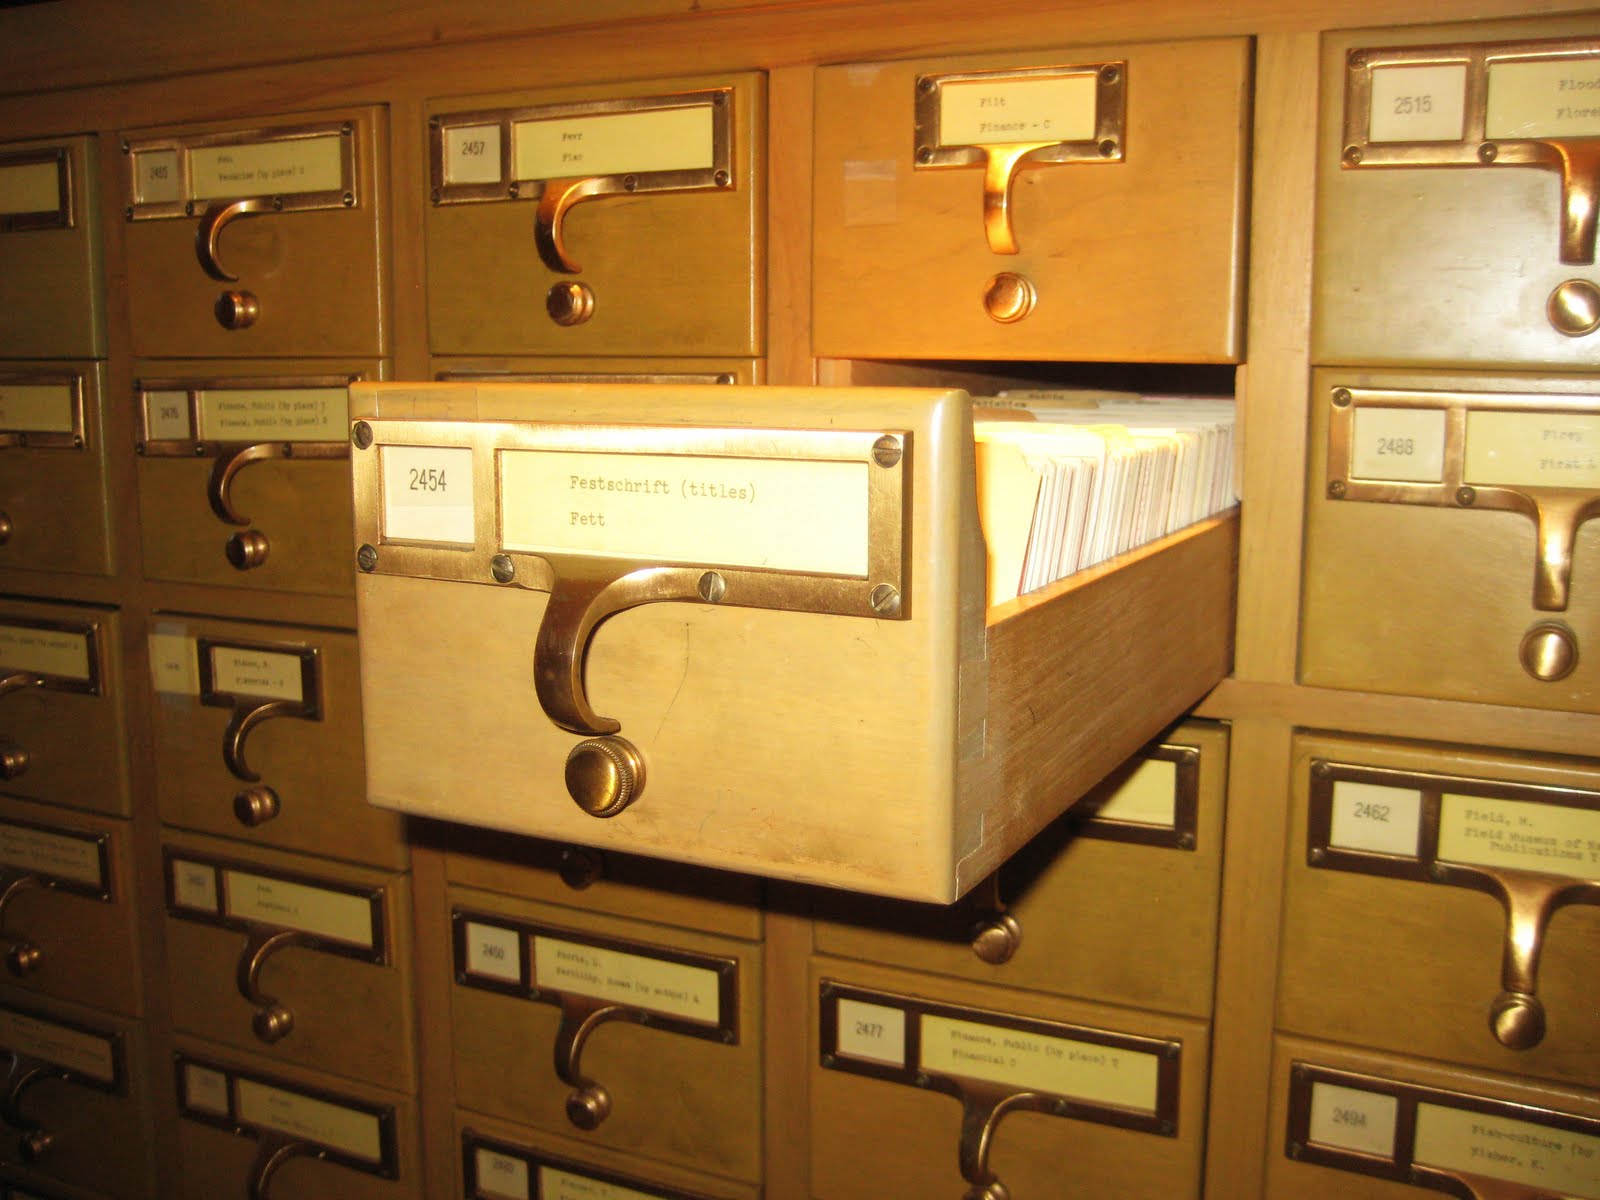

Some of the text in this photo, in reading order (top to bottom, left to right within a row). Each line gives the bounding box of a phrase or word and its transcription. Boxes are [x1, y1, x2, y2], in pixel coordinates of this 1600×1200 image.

[1393, 95, 1433, 115] 2515
[461, 141, 486, 156] 2457
[1376, 437, 1414, 456] 2488
[409, 467, 448, 493] 2454
[569, 475, 756, 504] Festschrift (titles)
[569, 511, 606, 527] Fett
[1353, 801, 1391, 823] 2462
[1464, 809, 1512, 826] Field,
[1464, 827, 1504, 841] Field
[1509, 831, 1558, 846] Museum
[1564, 838, 1582, 849] of
[855, 1020, 884, 1039] 2477
